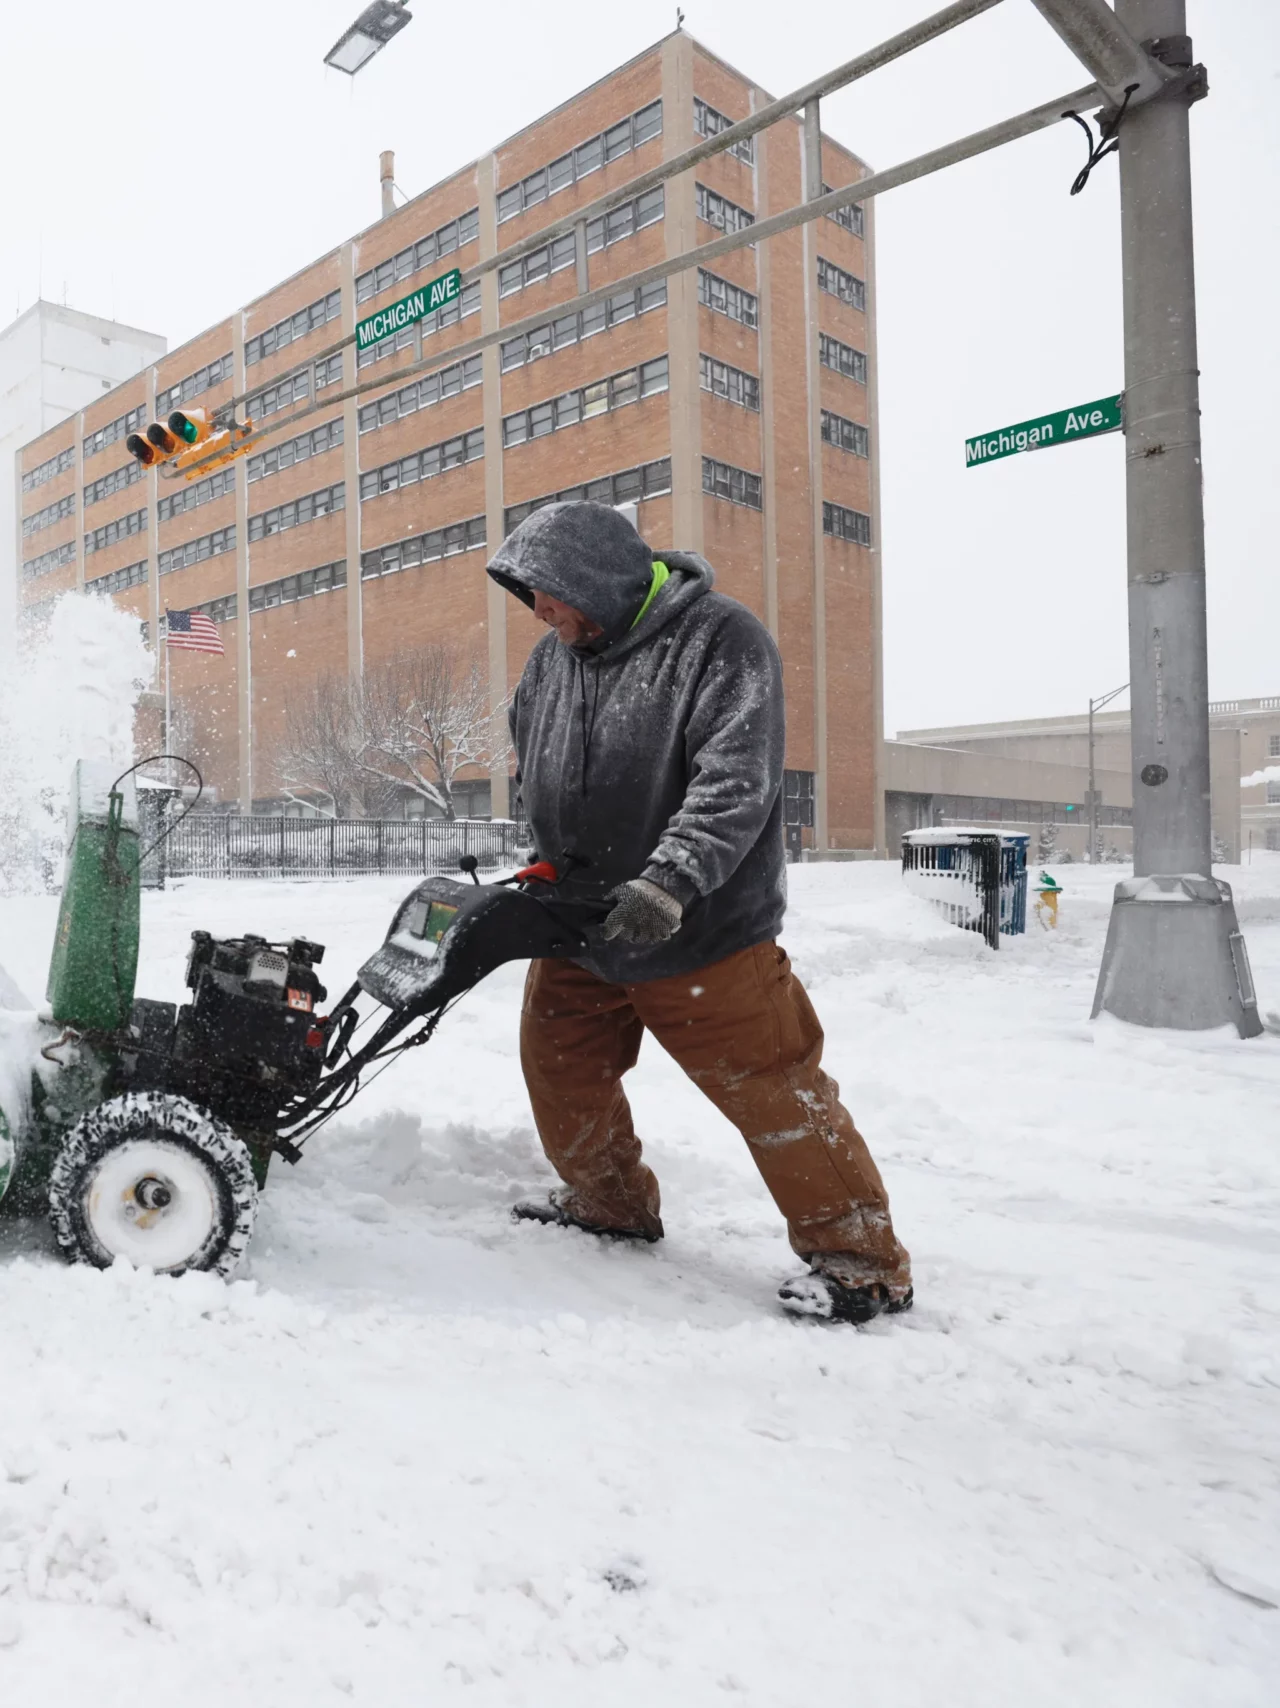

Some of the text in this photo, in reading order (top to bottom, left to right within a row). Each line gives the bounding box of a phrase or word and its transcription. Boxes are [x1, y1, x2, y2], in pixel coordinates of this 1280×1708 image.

[358, 274, 460, 346] MICHIGAN AVE.
[965, 409, 1110, 463] Michigan Ave.
